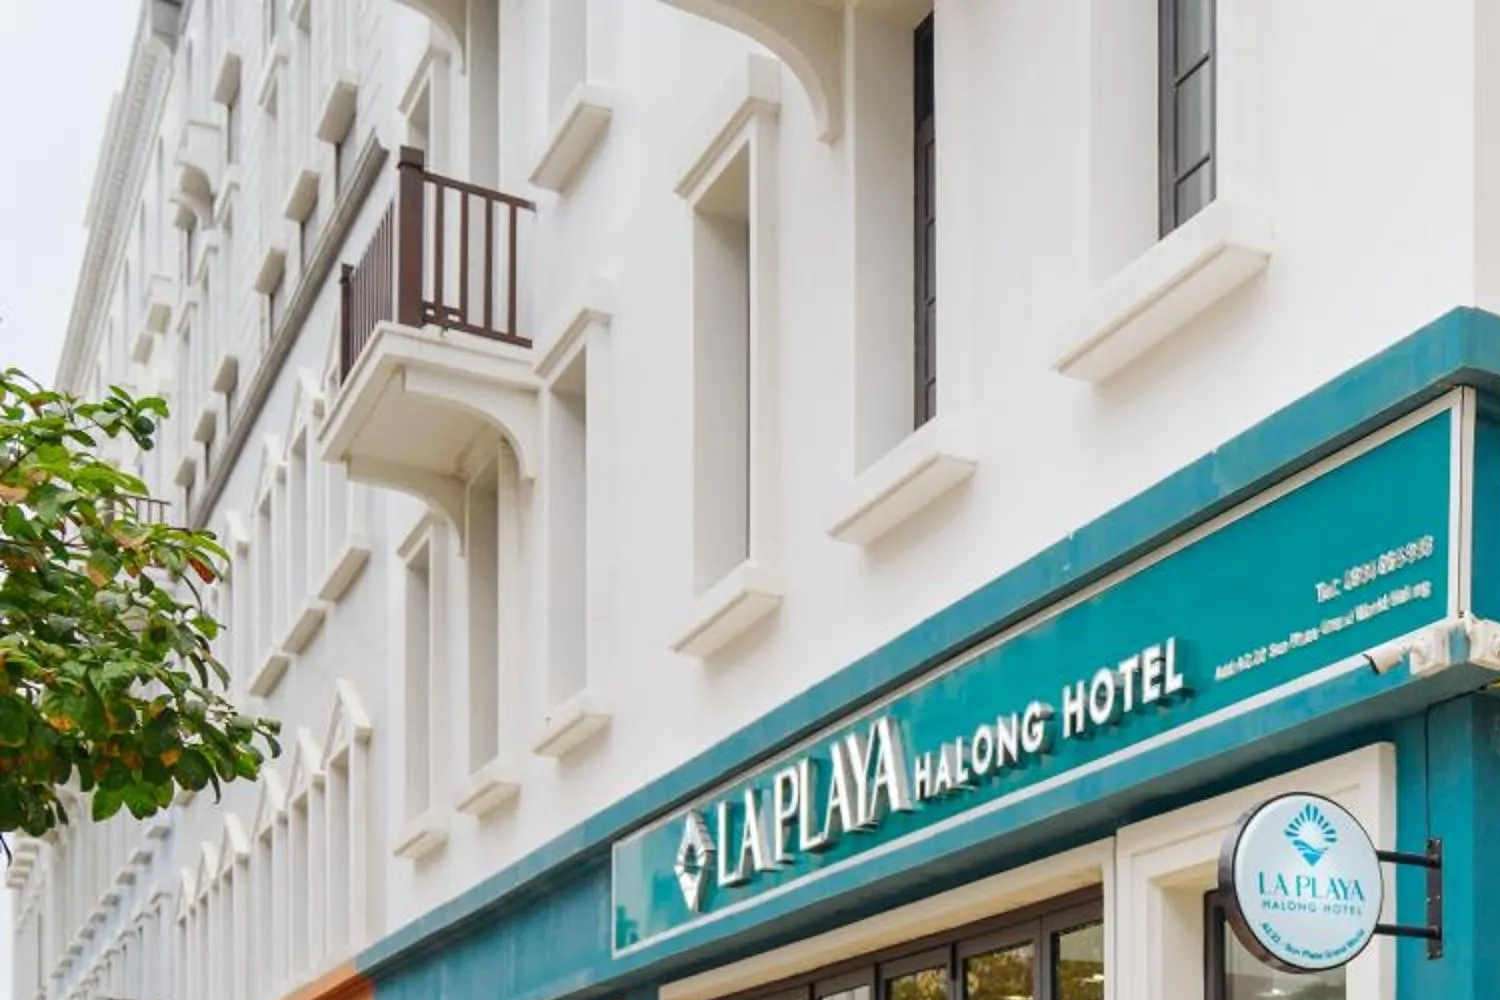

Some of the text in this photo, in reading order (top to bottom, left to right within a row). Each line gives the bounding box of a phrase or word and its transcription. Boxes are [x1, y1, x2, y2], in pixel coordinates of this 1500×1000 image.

[717, 636, 1183, 887] LA PLAYA HALONG HOTEL
[1258, 871, 1365, 901] LA PLAYA
[1262, 900, 1363, 917] HALONG HOTEL
